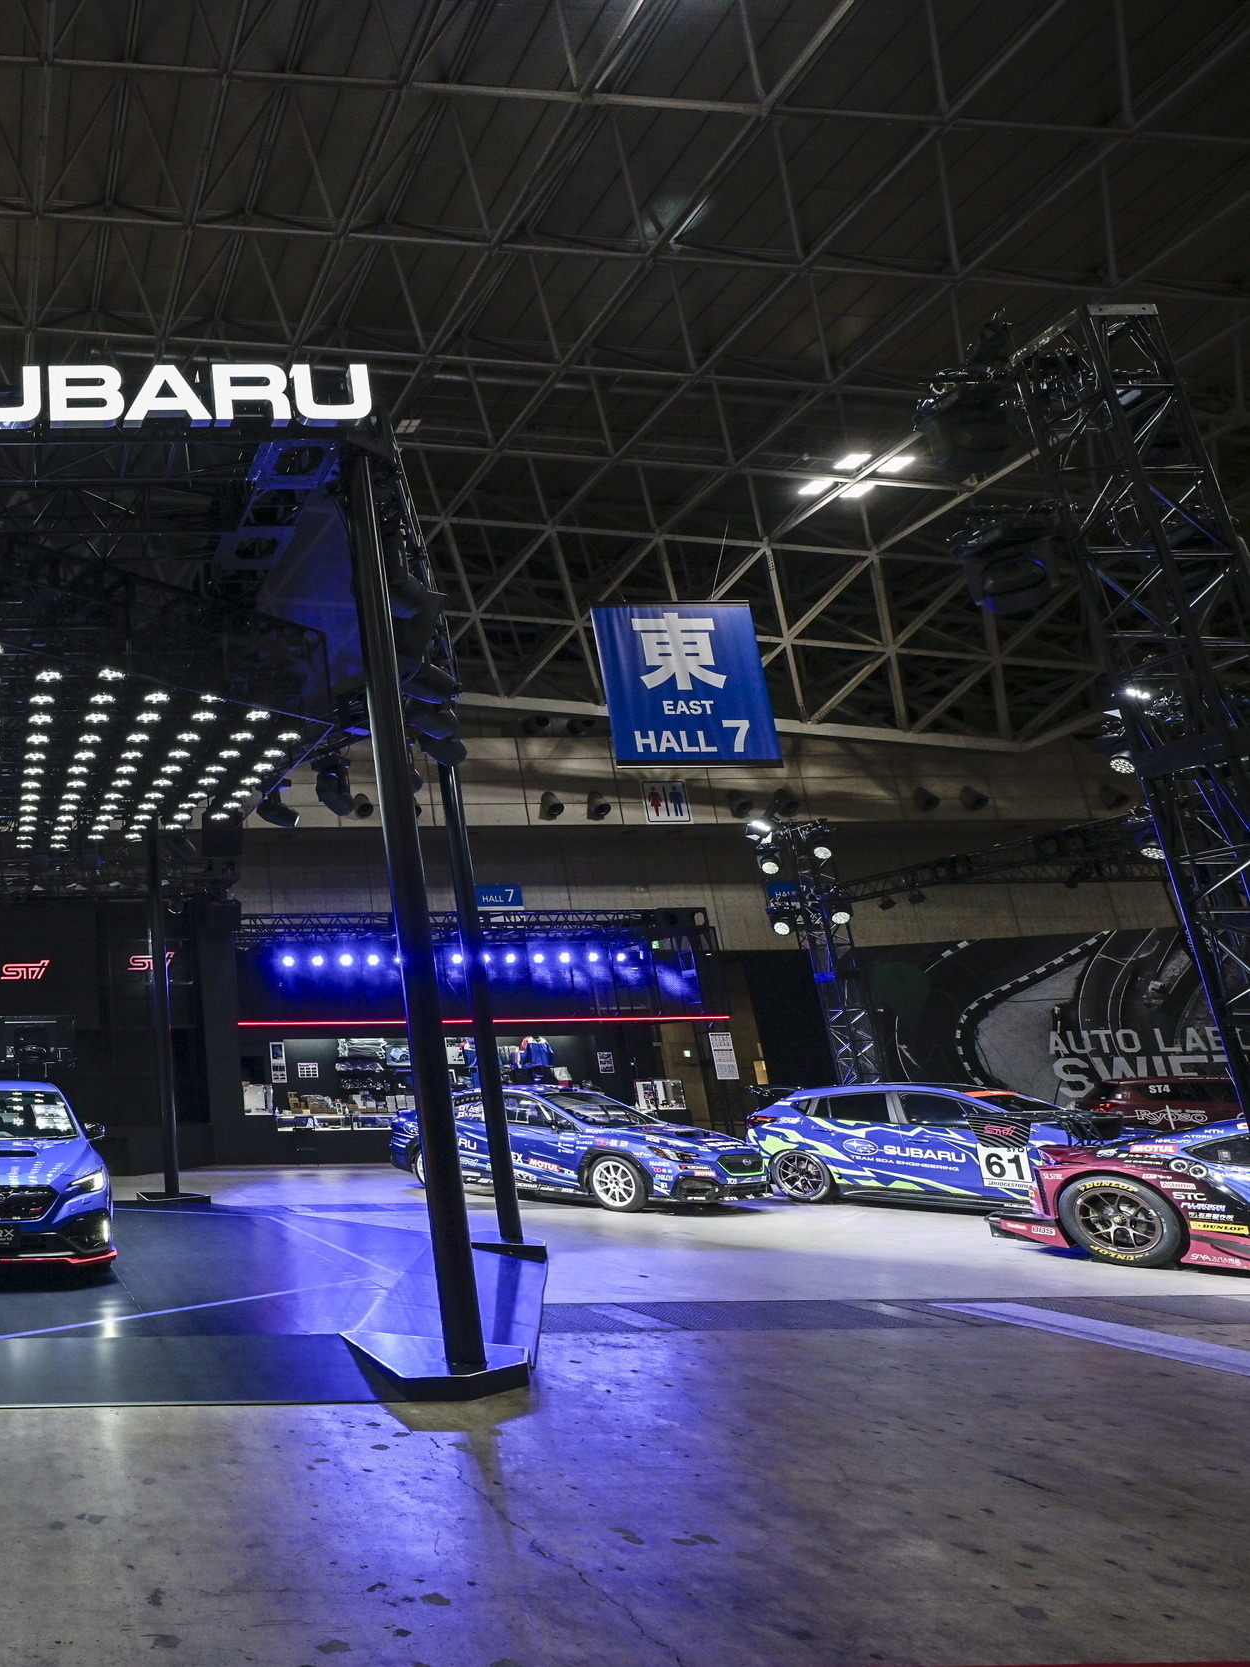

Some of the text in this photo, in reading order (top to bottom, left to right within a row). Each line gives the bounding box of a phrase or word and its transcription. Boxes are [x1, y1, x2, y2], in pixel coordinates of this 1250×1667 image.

[631, 612, 727, 690] 東
[662, 700, 714, 715] EAST
[634, 719, 750, 753] HALL 7
[482, 889, 514, 903] HALL 7
[1049, 1028, 1142, 1055] AUTO
[1052, 1055, 1229, 1099] SWIF
[1148, 1084, 1170, 1094] ST4
[883, 1144, 967, 1164] SUBARU
[1132, 1145, 1175, 1153] MOTUL
[529, 1158, 561, 1172] MOTUL
[850, 1154, 875, 1162] TEAM
[895, 1160, 960, 1172] ENGINEERING
[985, 1152, 1025, 1181] 61
[1078, 1181, 1139, 1193] DUNLOP
[1162, 1181, 1195, 1189] Astemo
[1172, 1191, 1207, 1201] STC
[1032, 1226, 1055, 1235] BBS
[1202, 1224, 1245, 1232] DUNLOP
